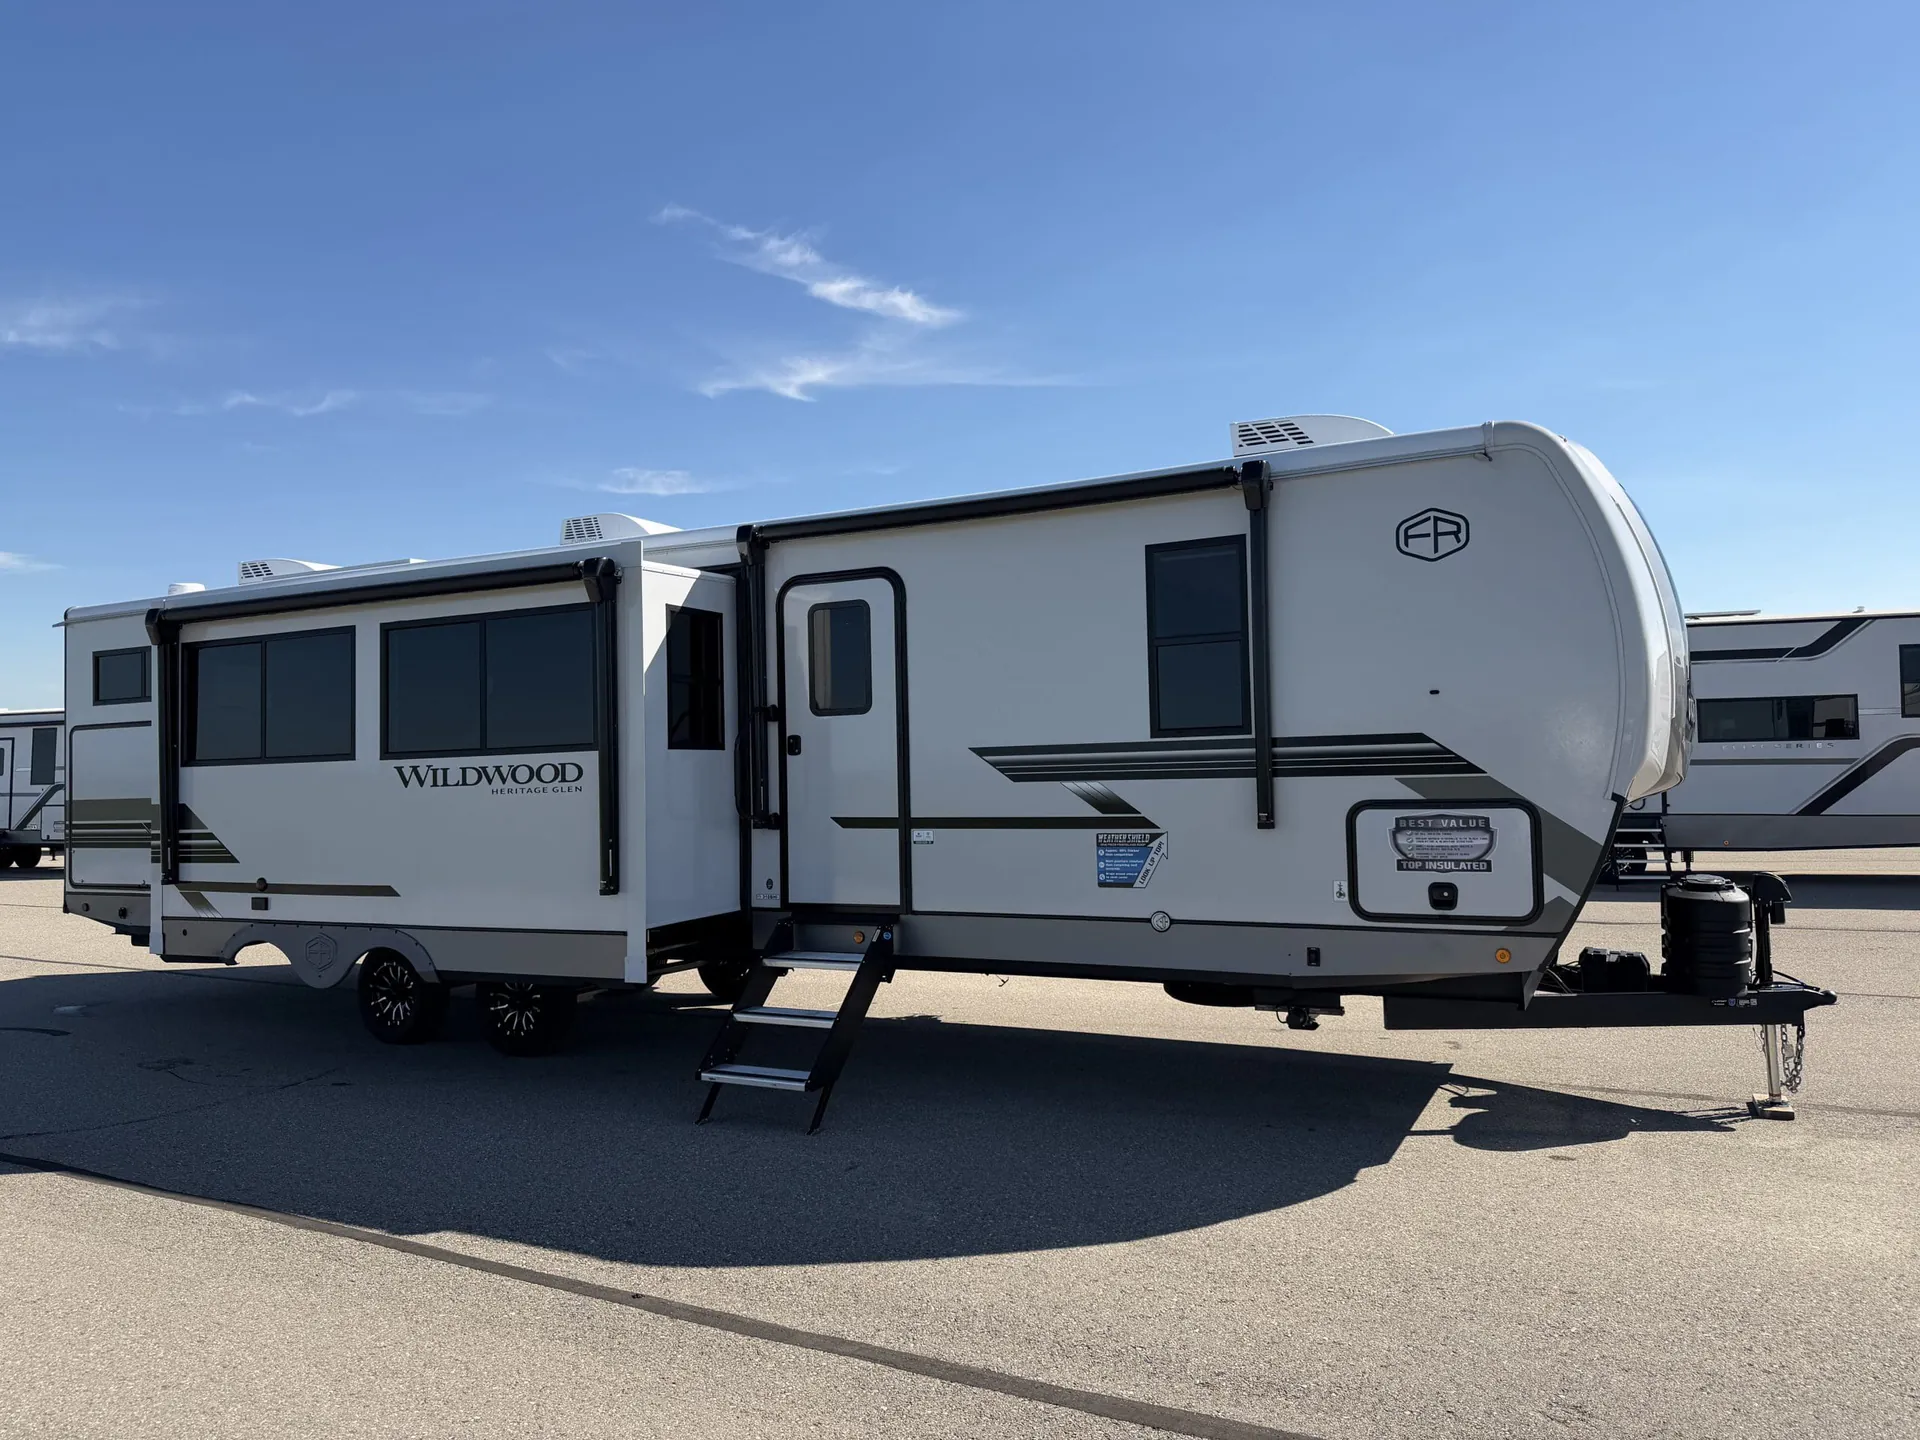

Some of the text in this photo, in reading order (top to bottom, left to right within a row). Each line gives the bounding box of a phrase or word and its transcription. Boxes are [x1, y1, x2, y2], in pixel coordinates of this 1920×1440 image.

[1403, 515, 1462, 555] FR
[393, 762, 584, 789] WILDWOOD
[491, 785, 583, 795] HERITAGE GLEN
[1399, 819, 1486, 828] BEST VALUE
[1138, 840, 1165, 885] LOOK UP TOP!
[1400, 861, 1487, 870] TOP INSULATED
